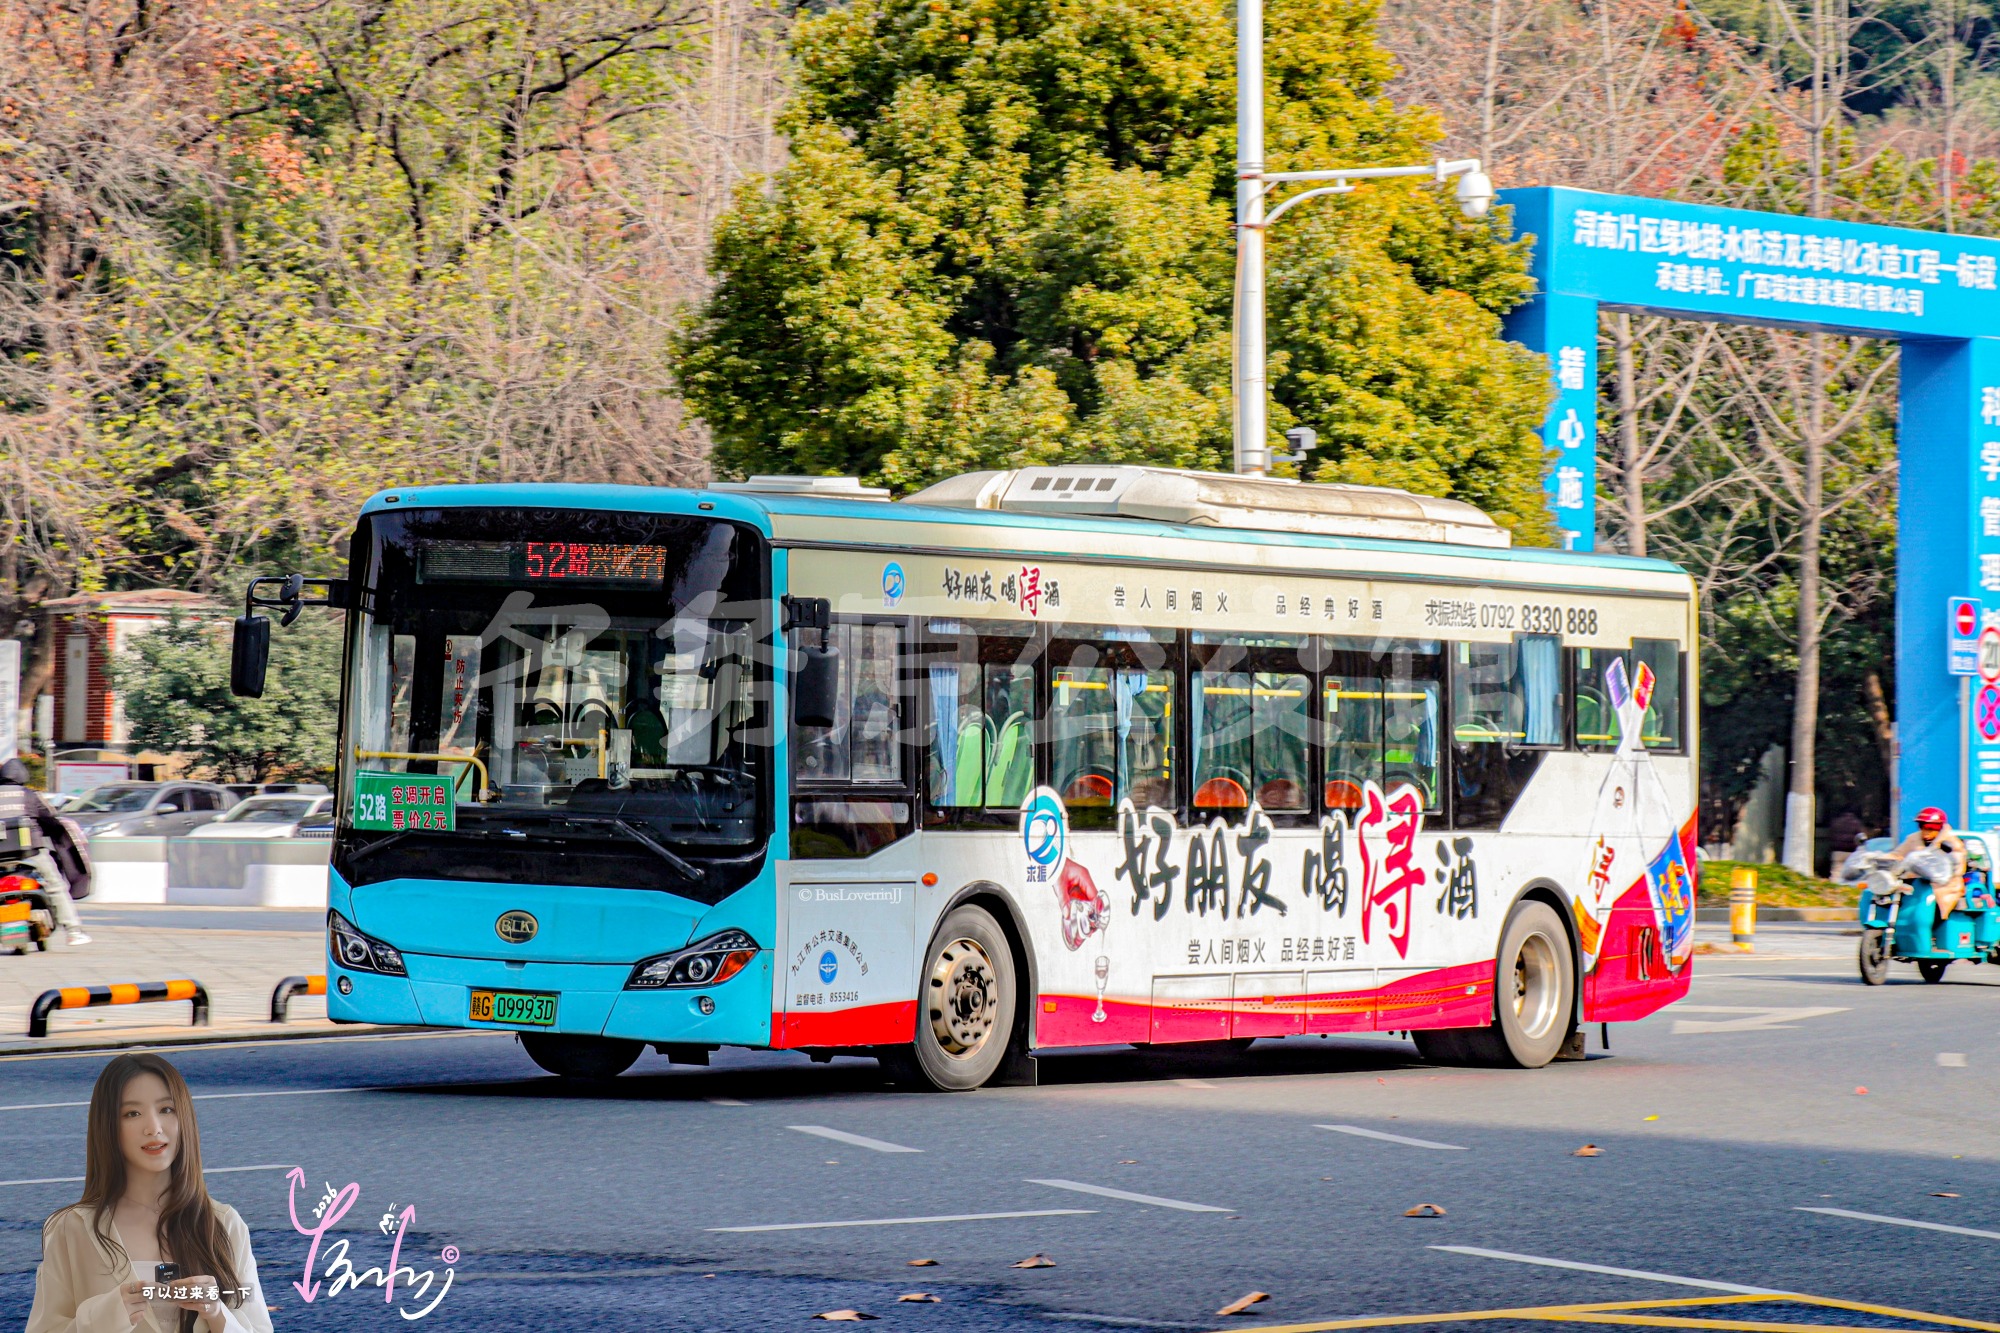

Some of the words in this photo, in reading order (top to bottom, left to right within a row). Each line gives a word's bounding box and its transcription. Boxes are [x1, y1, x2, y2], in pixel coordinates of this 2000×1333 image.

[1113, 585, 1229, 613] 尝人间烟火
[1275, 594, 1383, 620] 品经典好酒
[1480, 604, 1515, 628] 0792
[1521, 604, 1562, 633] 8330
[1566, 607, 1598, 635] 888
[453, 659, 466, 724] 防止夹伤
[360, 793, 387, 822] 52路
[391, 784, 446, 805] 空调开启
[392, 810, 448, 830] 票价2元
[1115, 801, 1289, 921] 好朋友
[1303, 788, 1479, 960] 喝浔酒
[501, 918, 535, 933] BLK
[790, 929, 869, 977] 九江市公共交通集团公司
[1187, 938, 1266, 965] 尝人间烟火
[1280, 936, 1356, 963] 品经典好酒
[497, 996, 554, 1021] 09993D
[829, 990, 859, 1003] 8553416
